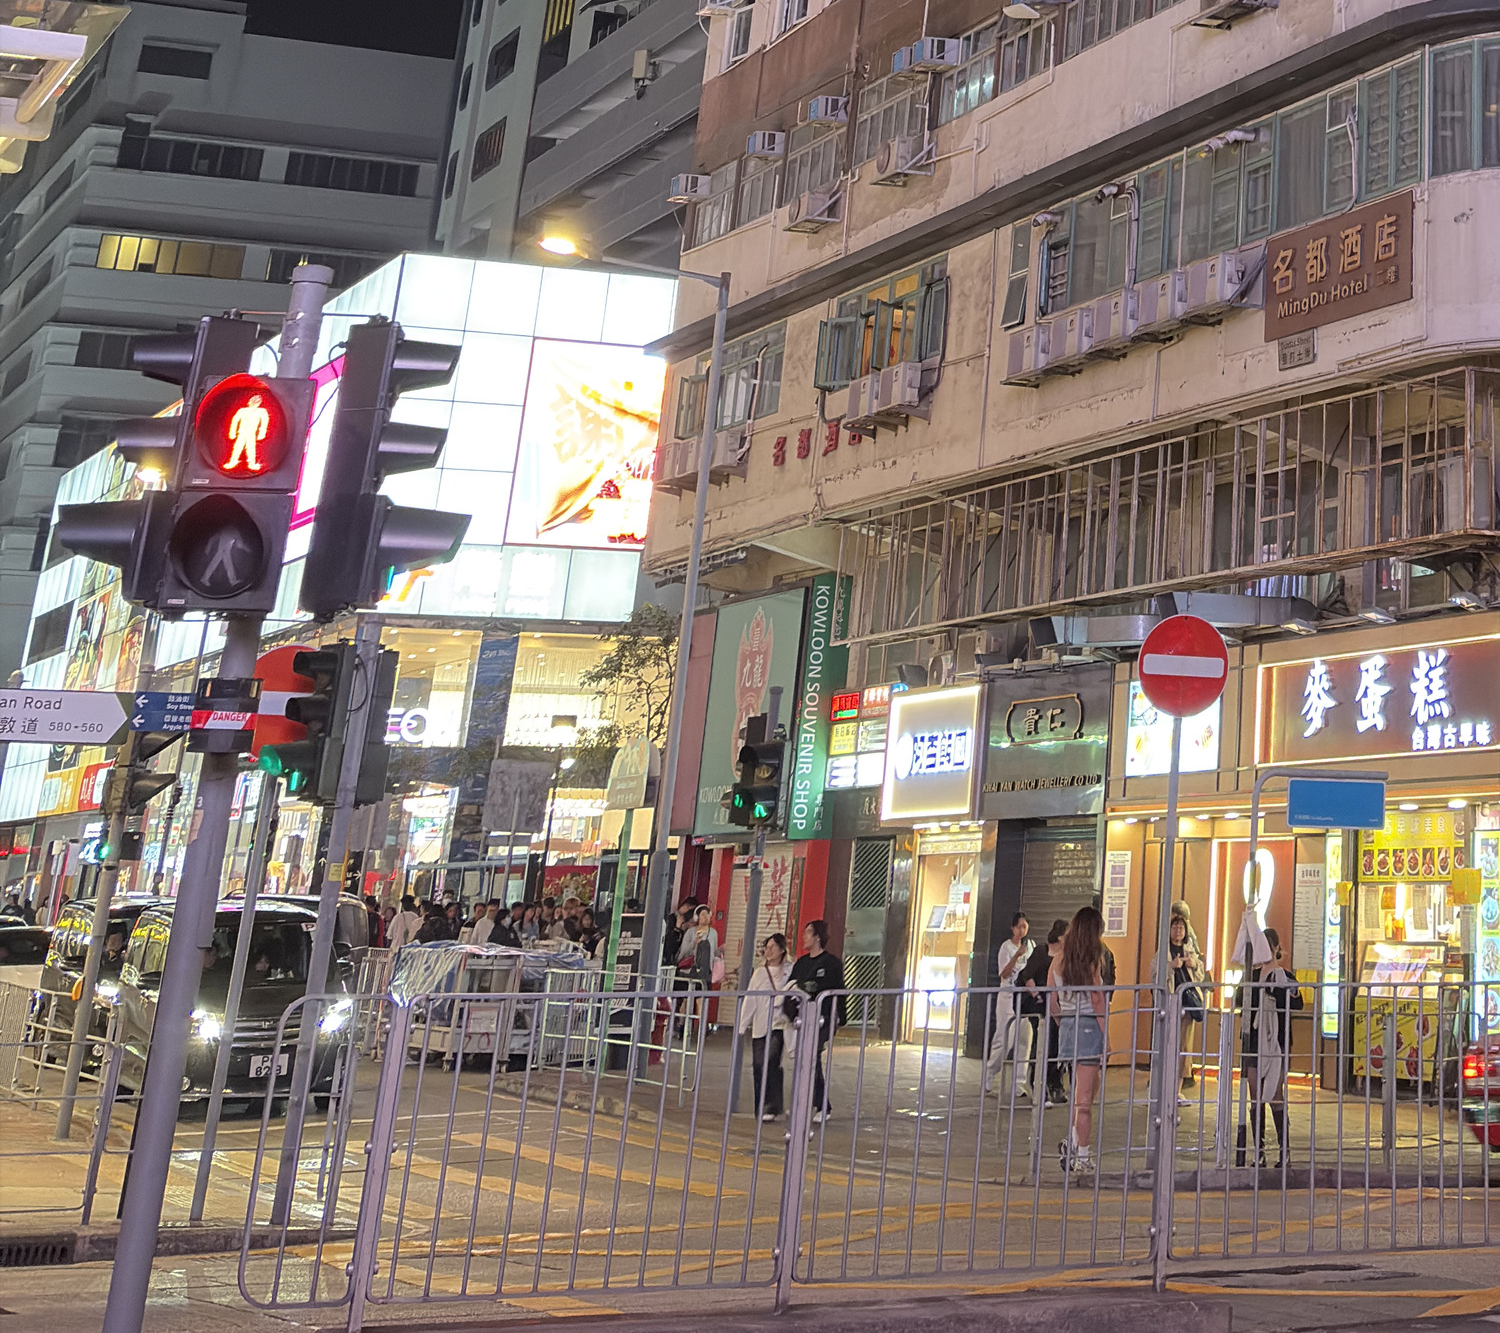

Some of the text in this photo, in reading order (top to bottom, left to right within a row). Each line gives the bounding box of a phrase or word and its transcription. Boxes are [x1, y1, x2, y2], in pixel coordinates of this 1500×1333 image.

[1273, 214, 1397, 295] 名都酒店
[1278, 274, 1368, 319] MingDu Hotel
[23, 696, 63, 710] Road
[793, 584, 831, 830] KOWLOON SOUVENIR SHOP
[1301, 649, 1449, 739] 麥蛋糕
[212, 712, 247, 722] DANGER
[1024, 708, 1064, 735] 貴仁
[1411, 720, 1492, 751] 台灣古早味
[1000, 781, 1013, 792] YAN
[1015, 779, 1036, 791] WATCH
[1038, 775, 1073, 790] JEWELLERY
[1074, 775, 1084, 787] CO
[1085, 774, 1099, 786] LTD
